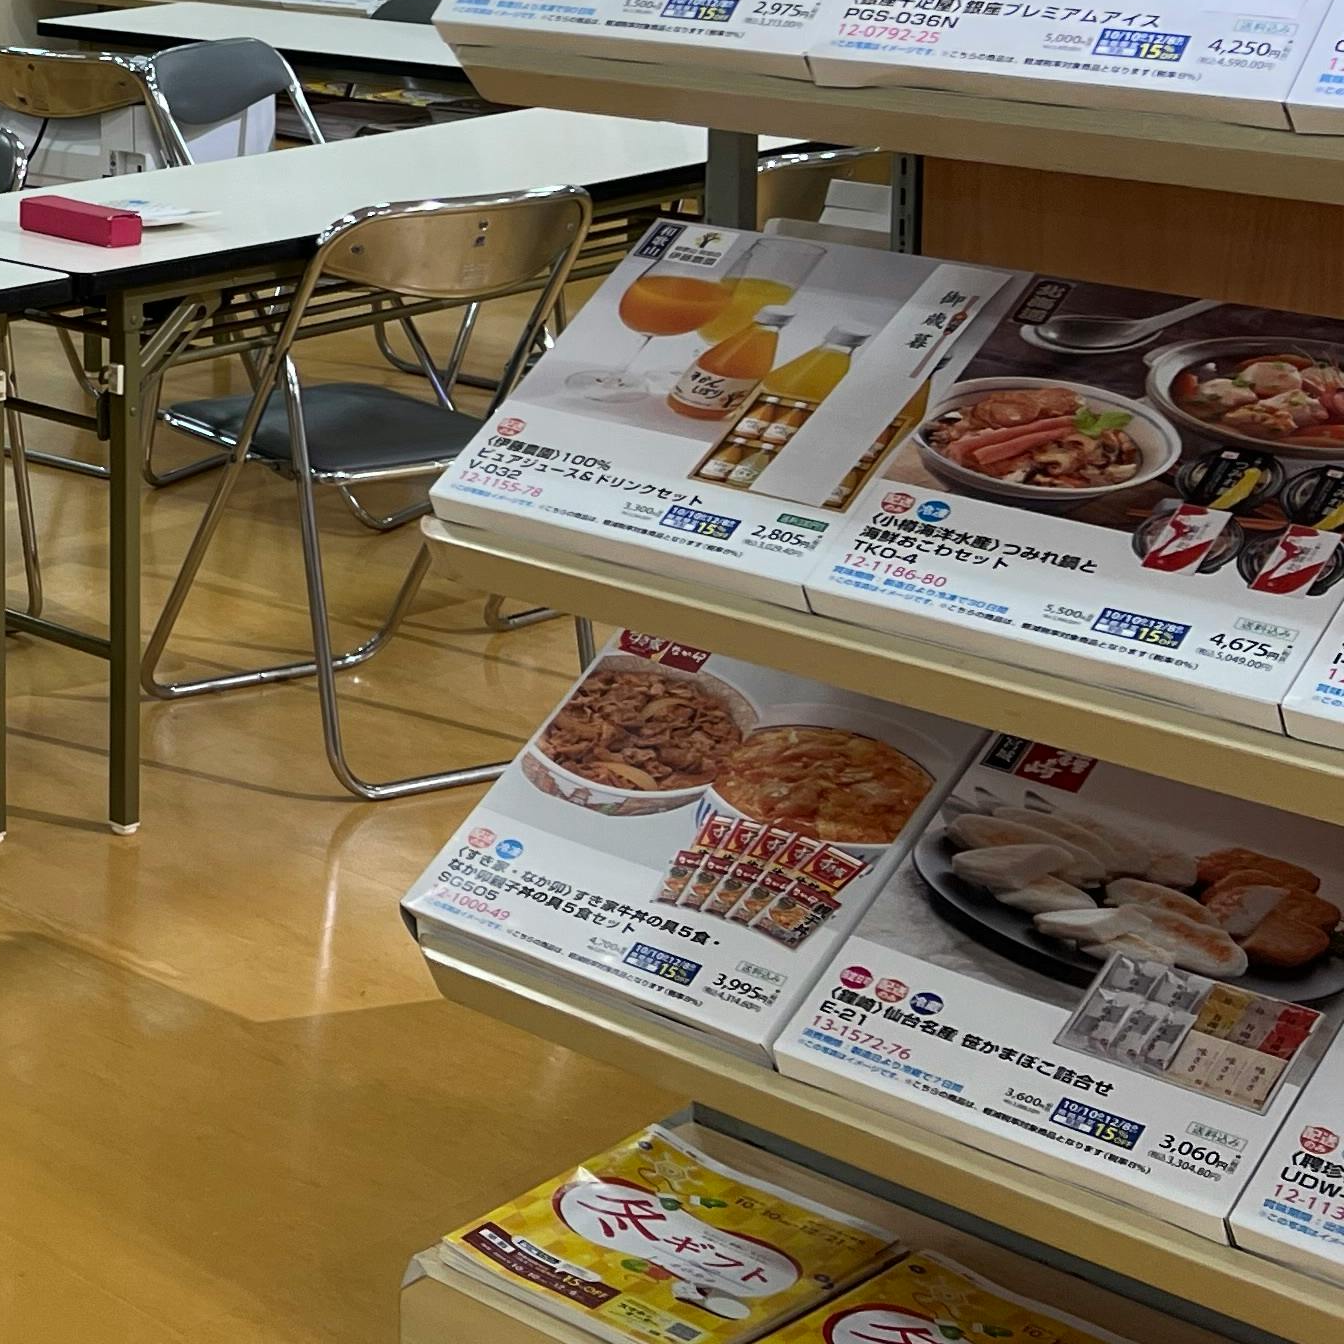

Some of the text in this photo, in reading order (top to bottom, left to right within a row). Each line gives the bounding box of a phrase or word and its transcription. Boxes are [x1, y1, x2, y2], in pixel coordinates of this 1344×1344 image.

[843, 7, 960, 29] PGS-036N
[837, 23, 942, 44] 12-0792-25
[1139, 43, 1162, 59] 15
[1207, 38, 1282, 57] 4,250円
[469, 459, 523, 481] V-032
[459, 470, 544, 498] 12-1155-78
[853, 539, 919, 565] TKO-4
[859, 525, 1010, 570] 海鮮おこわセット
[842, 553, 948, 588] 12-1186-80
[1137, 627, 1160, 643] 15
[1209, 632, 1280, 661] 4,675円
[437, 870, 500, 902] SG505
[659, 963, 679, 978] 15
[819, 1000, 869, 1027] E-21
[811, 1015, 912, 1061] 13-1572-76
[961, 1033, 1115, 1097] 笹かまぼこ詰合せ
[1094, 1123, 1116, 1142] 15
[1158, 1134, 1229, 1172] 3,060円
